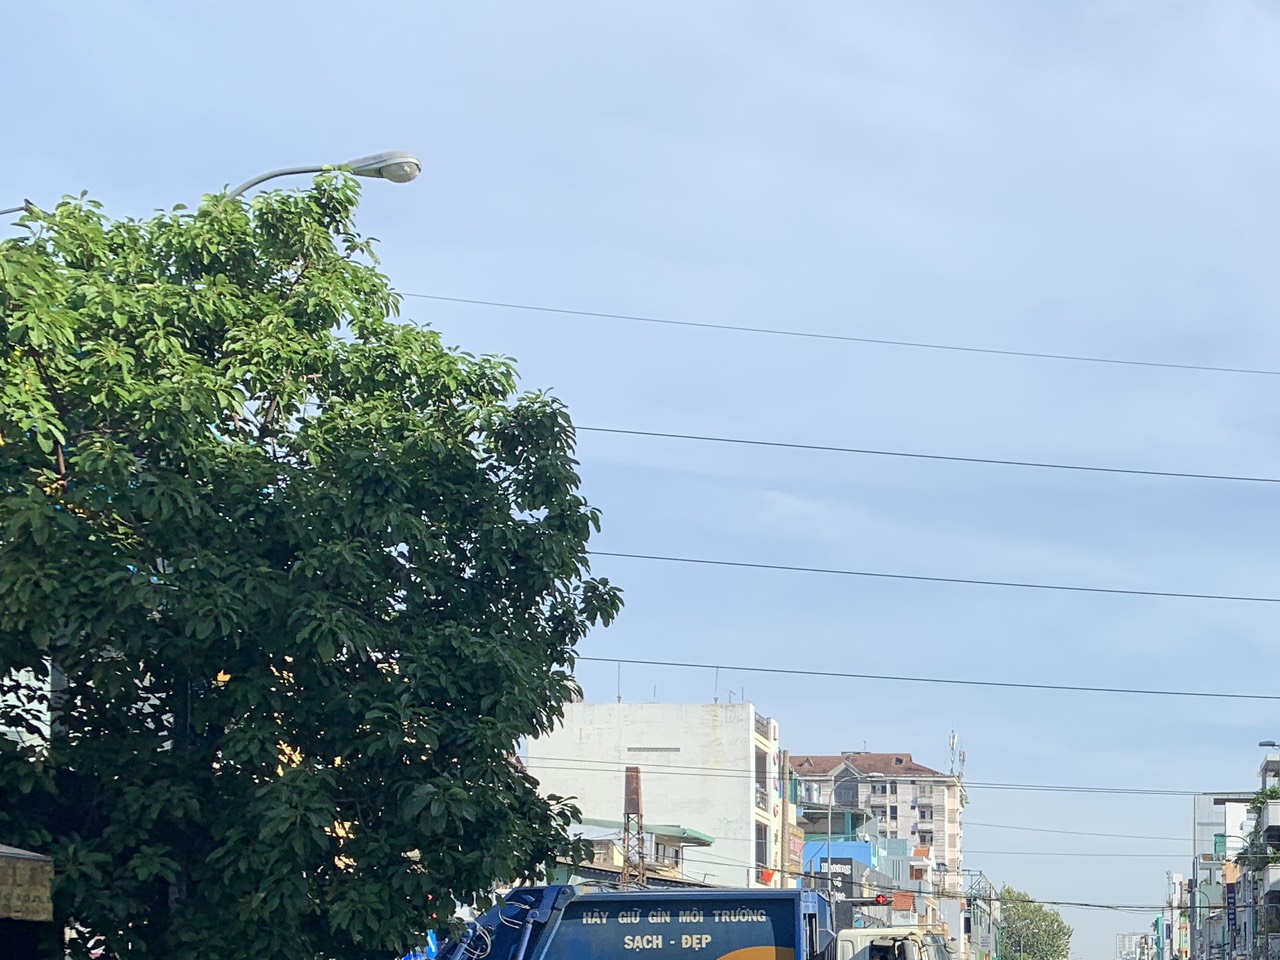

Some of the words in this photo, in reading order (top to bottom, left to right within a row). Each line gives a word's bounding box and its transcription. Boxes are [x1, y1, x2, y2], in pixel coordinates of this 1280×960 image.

[617, 908, 642, 924] GIỮ
[678, 907, 704, 923] MÔI
[712, 905, 767, 923] TRƯỜNG
[624, 934, 663, 952] SẠCH
[681, 934, 712, 951] ĐẸP
